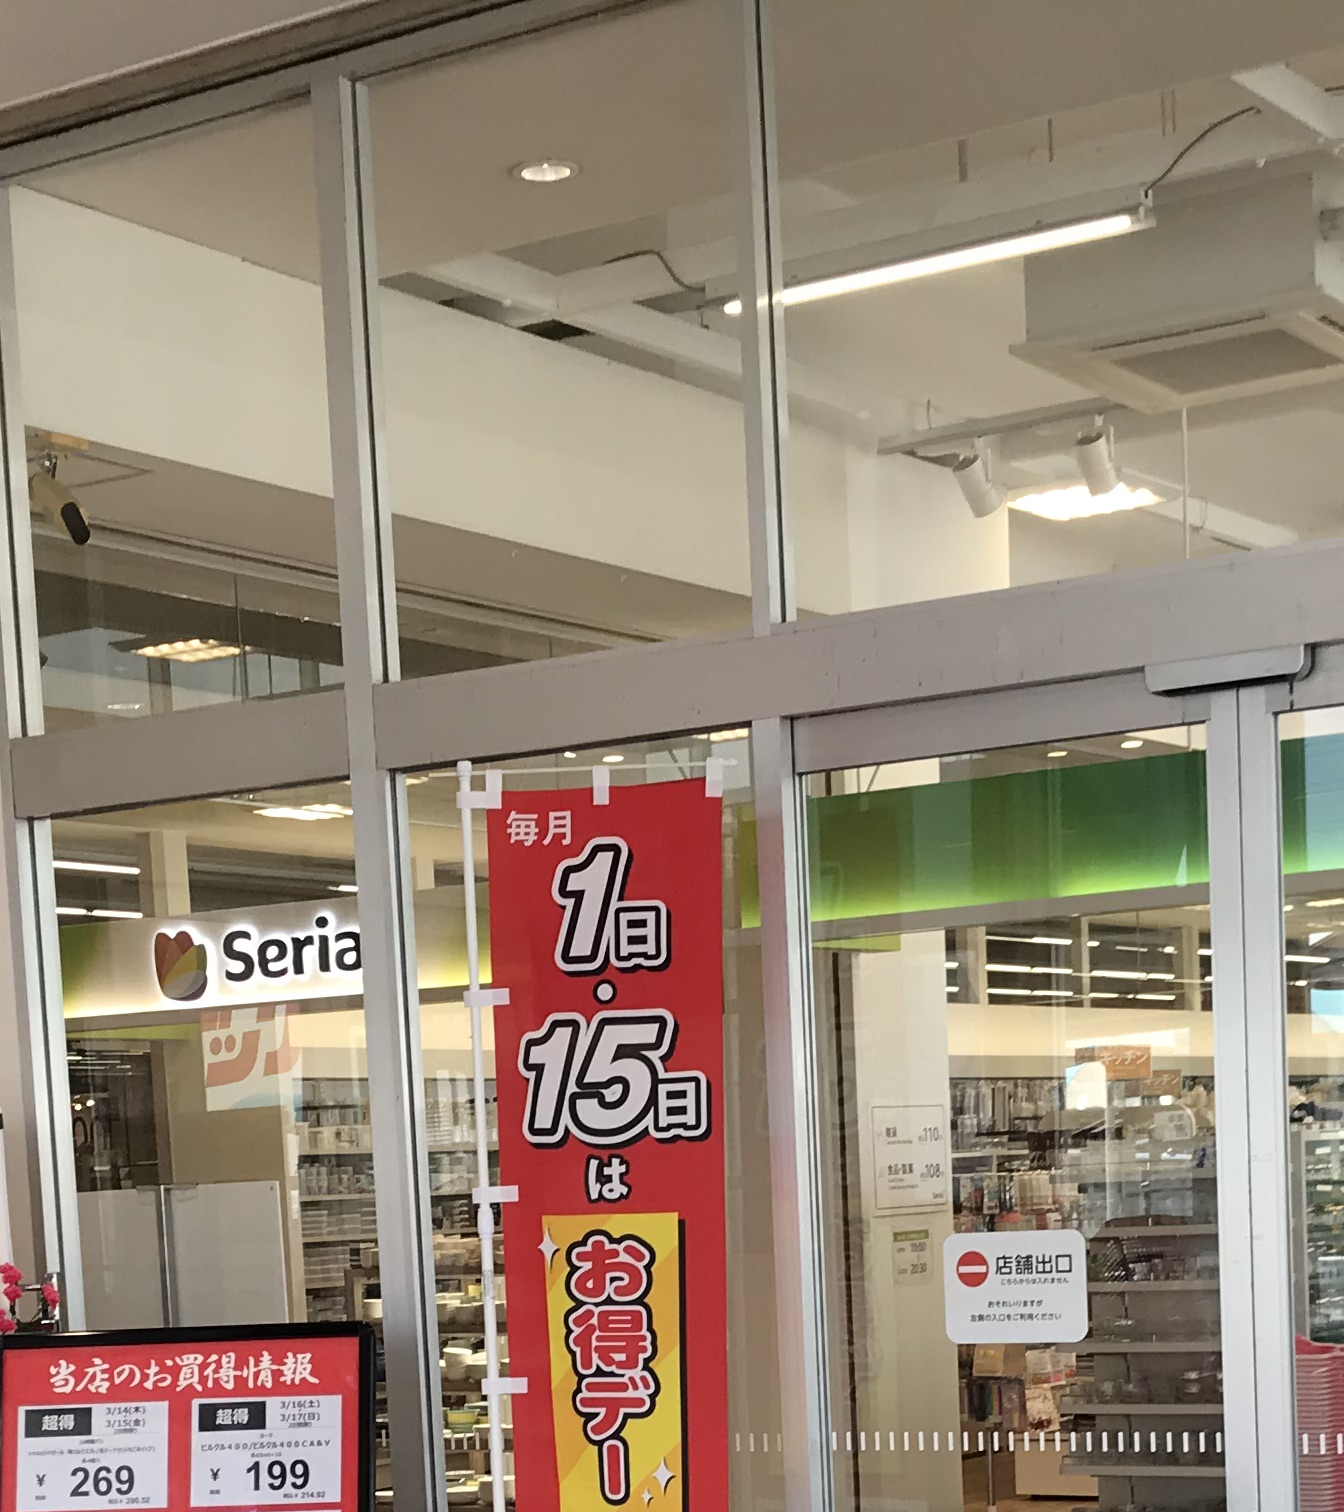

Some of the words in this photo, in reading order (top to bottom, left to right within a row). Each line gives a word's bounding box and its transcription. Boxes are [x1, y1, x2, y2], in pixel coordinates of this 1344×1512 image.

[506, 810, 572, 846] 毎月
[223, 915, 362, 983] Seria
[518, 1008, 710, 1150] 15日
[584, 1155, 631, 1203] は
[995, 1253, 1072, 1275] 店舗出口
[49, 1351, 320, 1394] 当店のお買得情報
[564, 1230, 660, 1505] お得デー
[105, 1406, 146, 1415] 3/14(木)
[215, 1408, 249, 1425] 超得
[280, 1400, 320, 1409] 3/16(土)
[280, 1412, 320, 1422] 3/17(日)
[41, 1414, 75, 1431] 超得
[69, 1465, 135, 1497] 269
[246, 1459, 310, 1491] 199
